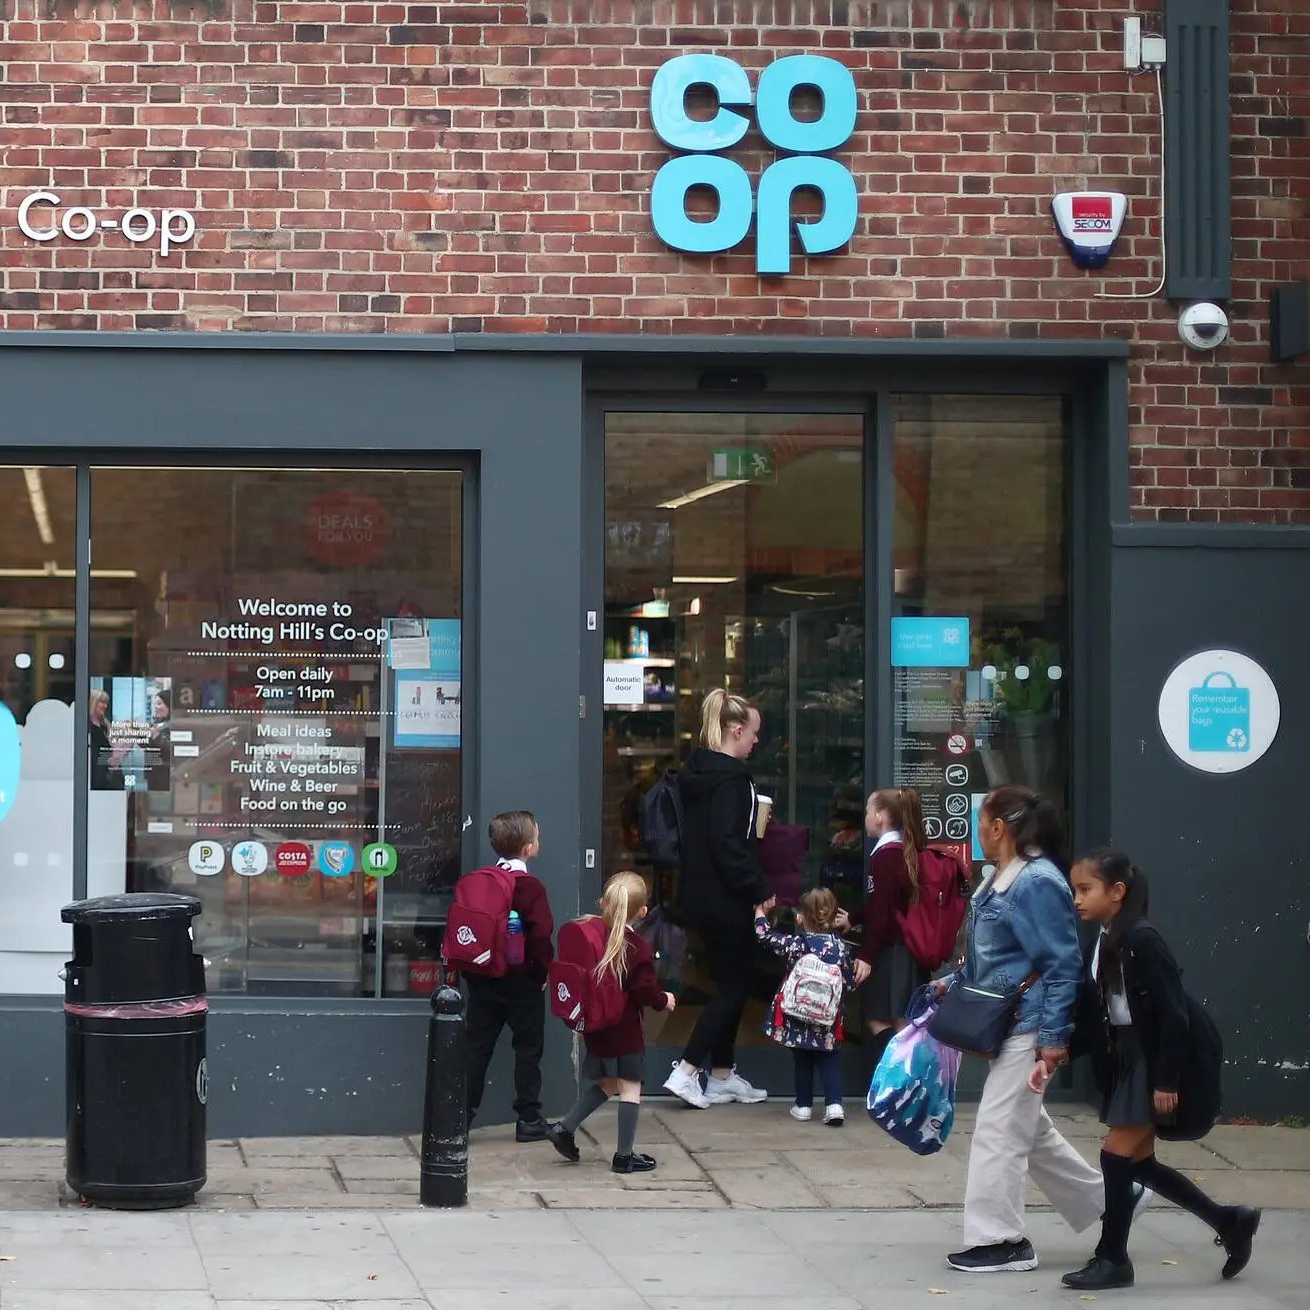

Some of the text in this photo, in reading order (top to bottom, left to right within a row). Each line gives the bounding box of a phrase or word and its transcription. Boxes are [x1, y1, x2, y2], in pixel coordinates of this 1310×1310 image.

[17, 191, 197, 257] Co-op
[1074, 219, 1111, 229] SECOM
[318, 514, 373, 530] DEALS
[238, 598, 353, 618] Welcome to
[201, 621, 389, 646] Notting Hill's Co-op
[256, 666, 334, 684] Open daily
[254, 684, 285, 699] 7am
[296, 685, 335, 702] 11pm
[1192, 693, 1238, 704] Remember
[124, 729, 151, 737] sharing
[257, 723, 332, 738] Meal ideas
[118, 736, 150, 744] moment
[244, 741, 344, 760] Instore bakery
[230, 760, 358, 777] Fruit & Vegetables
[250, 779, 338, 793] Wine & Beer
[240, 797, 347, 815] Food on the go
[278, 852, 307, 861] COSTA
